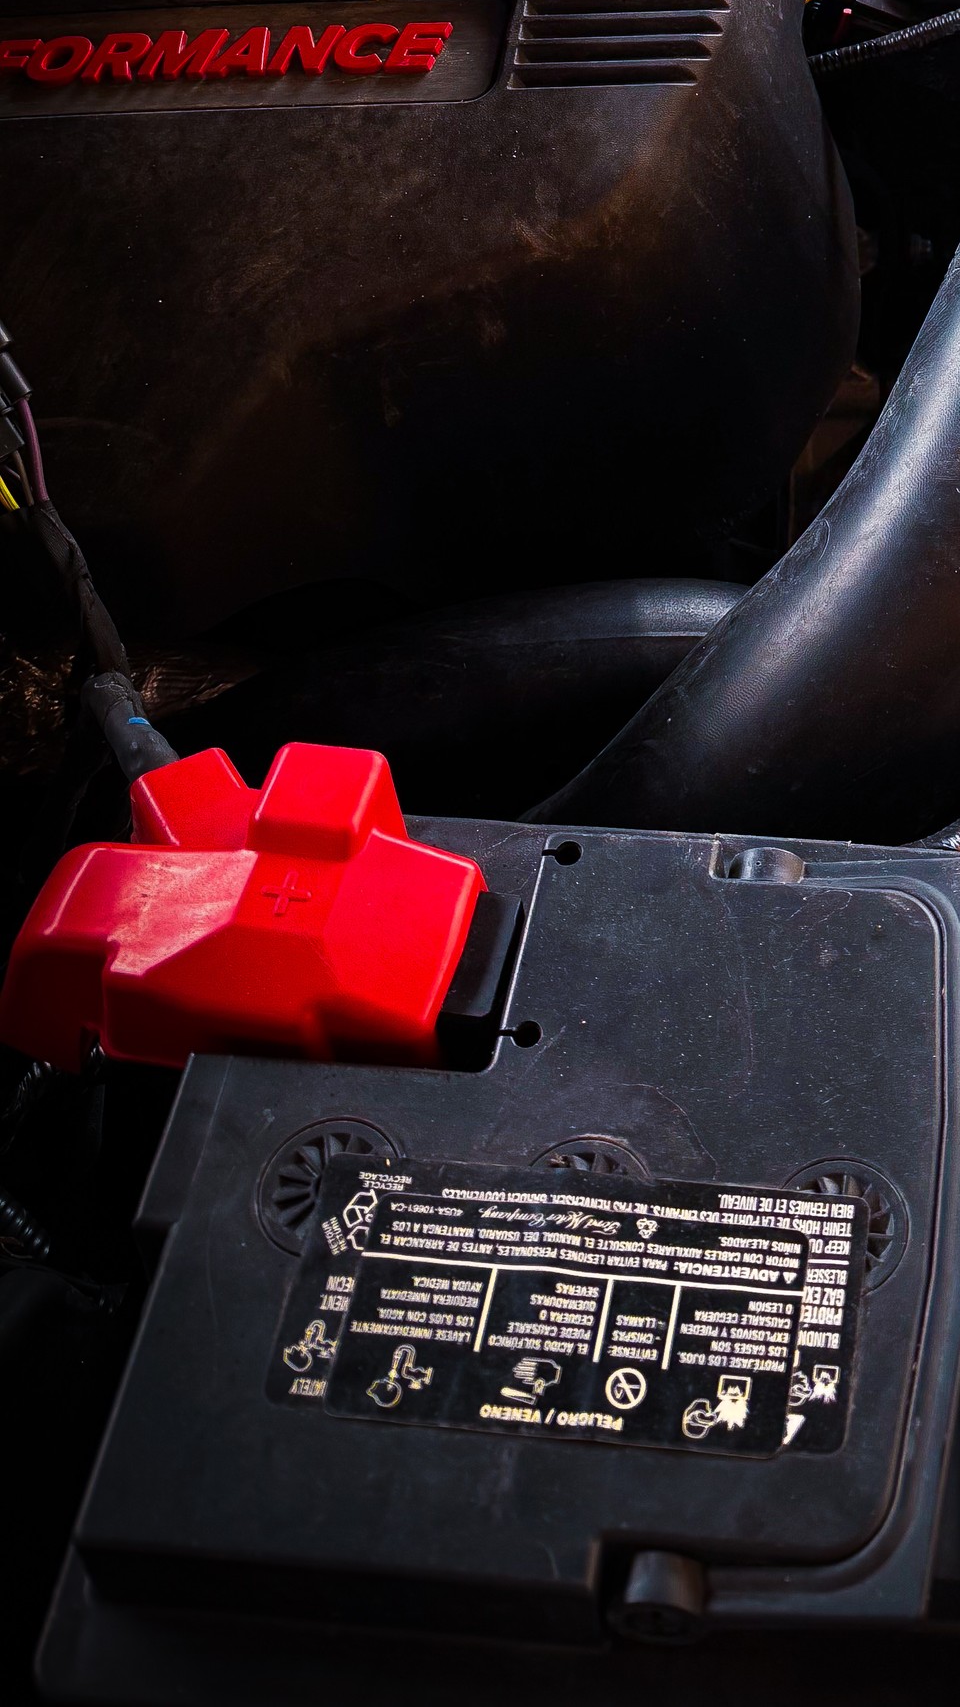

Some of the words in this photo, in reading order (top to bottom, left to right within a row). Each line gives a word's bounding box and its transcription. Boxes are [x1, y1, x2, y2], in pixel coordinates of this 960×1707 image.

[0, 21, 453, 85] FORMANCE
[357, 1170, 411, 1183] RECYCLAGE
[361, 1179, 403, 1191] RECYCLE
[759, 1196, 772, 1212] DE
[775, 1198, 787, 1213] ET
[788, 1199, 829, 1218] FERMÉS
[830, 1203, 854, 1218] BIEN
[391, 1220, 411, 1232] LOS
[544, 1209, 588, 1230] Motor
[585, 1217, 620, 1236] Ford
[792, 1217, 820, 1234] HORS
[421, 1221, 474, 1237] MANTENGA
[477, 1226, 520, 1241] USUARIO.
[521, 1229, 539, 1241] DEL
[822, 1220, 851, 1236] TENIR
[379, 1232, 391, 1245] EL
[392, 1234, 444, 1250] ARRANCAR
[446, 1239, 459, 1251] DE
[541, 1230, 581, 1245] MANUAL
[582, 1235, 594, 1247] EL
[594, 1237, 644, 1253] CONSULTE
[718, 1235, 769, 1249] ALEJADOS.
[460, 1239, 492, 1254] ANTES
[495, 1241, 557, 1258] PERSONALES,
[646, 1242, 702, 1259] AUXILIARES
[770, 1239, 801, 1255] NIÑOS
[824, 1239, 850, 1254] KEEP
[558, 1246, 605, 1264] LESIONES
[607, 1253, 639, 1267] EVITAR
[704, 1248, 740, 1262] CABLES
[741, 1252, 763, 1264] CON
[765, 1254, 799, 1268] MOTOR
[642, 1256, 667, 1270] PARA
[672, 1260, 779, 1282] ADVERTENCIA:
[451, 1279, 481, 1292] AYUDA
[554, 1281, 599, 1296] SEVERAS
[379, 1287, 430, 1303] INMEDIATA
[432, 1291, 478, 1307] REQUIERA
[528, 1293, 596, 1310] QUEMADURAS
[823, 1287, 844, 1305] GAZ
[747, 1300, 782, 1314] LESIÓN
[406, 1309, 426, 1322] CON
[455, 1314, 474, 1326] LOS
[549, 1310, 593, 1325] CEGUERA
[615, 1314, 656, 1328] LLAMAS
[693, 1309, 738, 1325] CEGUERA
[739, 1313, 791, 1329] CAUSARLE
[559, 1326, 591, 1340] PUEDE
[679, 1322, 718, 1337] PUEDEN
[729, 1326, 789, 1342] EXPLOSIVOS
[543, 1339, 574, 1356] ÁCIDO
[710, 1339, 731, 1351] SON
[733, 1341, 765, 1354] GASES
[768, 1343, 787, 1357] LOS
[707, 1354, 727, 1367] LOS
[479, 1403, 541, 1423] VENENO
[556, 1411, 623, 1430] PELIGRO
